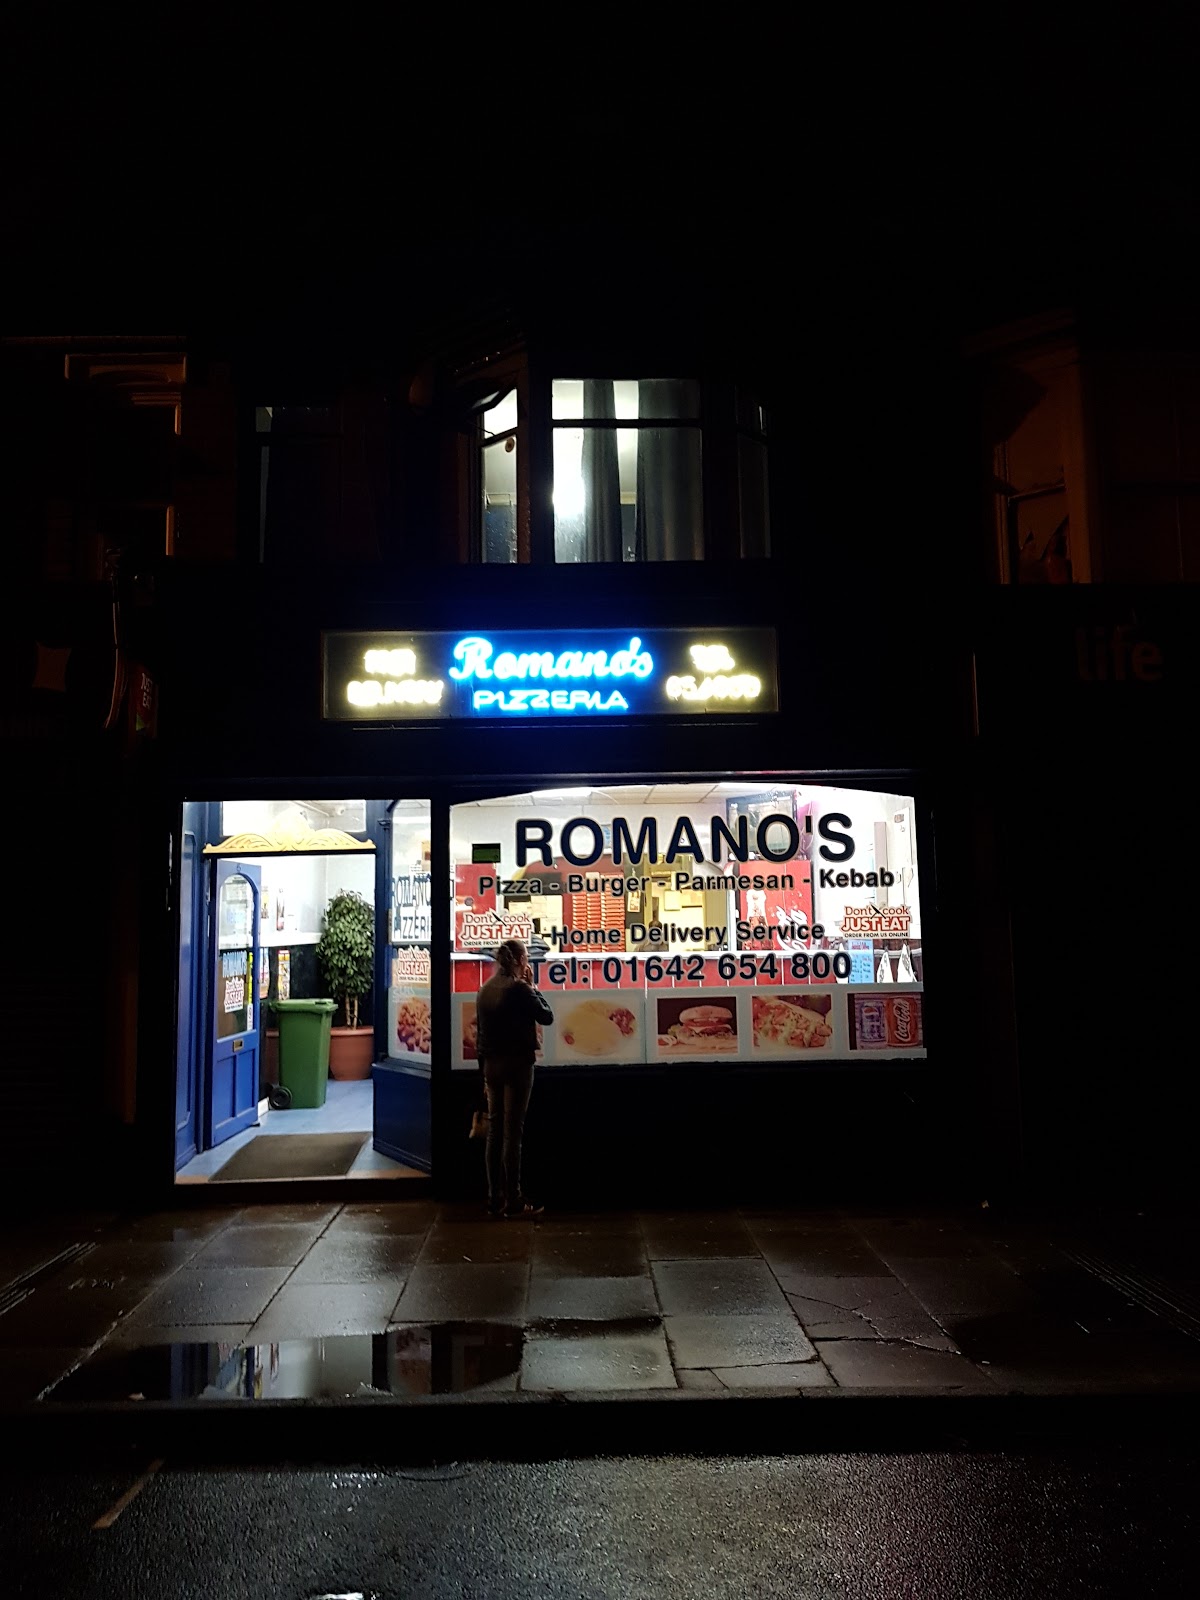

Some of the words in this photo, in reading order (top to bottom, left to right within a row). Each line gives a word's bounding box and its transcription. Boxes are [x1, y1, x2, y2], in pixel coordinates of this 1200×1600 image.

[449, 637, 653, 679] Romano's
[1075, 624, 1164, 680] life
[473, 690, 628, 710] PIZZERIA
[515, 813, 855, 867] ROMANO'S
[479, 876, 542, 895] Pizza
[569, 874, 649, 896] Burger
[676, 872, 793, 890] Parmesan
[820, 868, 894, 888] Kebab
[465, 913, 492, 923] Don't
[503, 913, 531, 923] cook
[846, 905, 872, 915] Don't
[883, 905, 909, 915] cook
[462, 925, 499, 940] JUST
[501, 924, 531, 938] EAT
[551, 926, 620, 944] Home
[631, 923, 727, 944] Delivery
[736, 922, 825, 940] Service
[841, 917, 878, 931] JUST
[881, 916, 910, 931] EAT
[529, 957, 588, 984] Tel:
[603, 954, 705, 982] 01642
[718, 953, 778, 980] 654
[791, 952, 852, 979] 800
